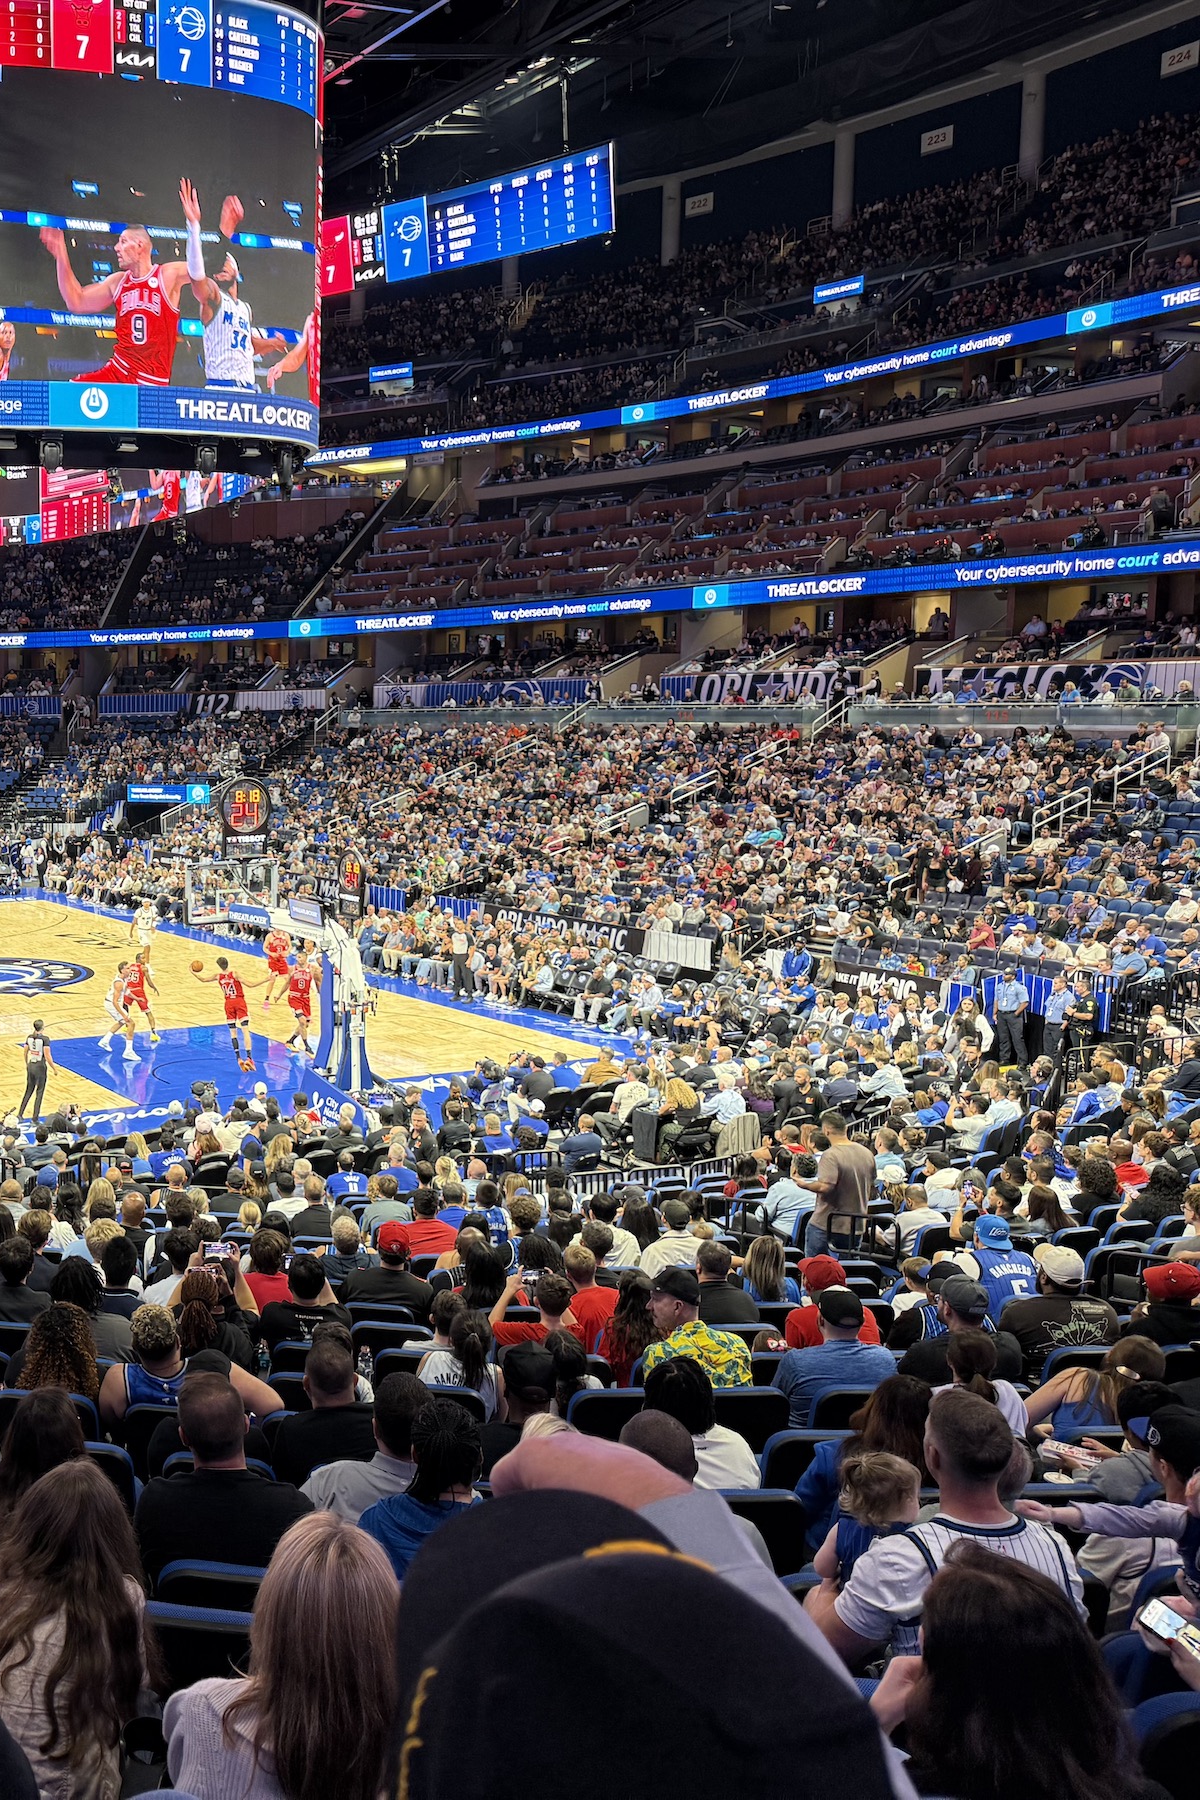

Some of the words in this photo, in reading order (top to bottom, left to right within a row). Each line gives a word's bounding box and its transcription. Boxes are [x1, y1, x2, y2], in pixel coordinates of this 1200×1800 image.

[130, 14, 141, 23] FLS
[228, 16, 248, 30] BLACK
[129, 23, 141, 33] TOL
[130, 33, 142, 42] CHL
[76, 35, 89, 59] 7
[179, 48, 191, 72] 7
[1168, 50, 1192, 67] 224
[927, 132, 947, 146] 223
[690, 198, 708, 210] 222
[353, 211, 378, 229] 8:18
[403, 248, 412, 266] 7
[326, 266, 336, 282] 7
[816, 282, 860, 298] THREATLOCKER
[131, 314, 147, 344] 9
[231, 330, 247, 351] 34
[824, 372, 843, 382] Your
[844, 359, 901, 380] cybersecurity
[903, 352, 929, 365] home
[931, 344, 957, 358] court
[960, 334, 1011, 353] advantage
[372, 368, 412, 377] THREATLOCKER
[688, 388, 769, 410] THREATLOCKER
[176, 399, 312, 430] THREATLOCKER
[440, 432, 490, 448] cybersecurity
[492, 430, 515, 439] home
[517, 426, 539, 436] court
[540, 420, 580, 433] advantage
[304, 445, 372, 462] REATLOCKER
[955, 569, 983, 581] Your
[986, 560, 1072, 581] cybersecurity
[1075, 558, 1114, 571] home
[1118, 552, 1159, 568] court
[767, 577, 864, 598] THREATLOCKER
[492, 610, 510, 619] Your
[511, 605, 563, 620] cybersecurity
[564, 605, 586, 614] home
[587, 602, 608, 612] court
[610, 599, 651, 610] advantage
[356, 615, 434, 629] THREATLOCKER
[90, 634, 108, 642] Your
[110, 632, 163, 643] cybersecurity
[164, 631, 187, 639] home
[188, 630, 210, 638] court
[212, 628, 254, 638] advantage
[196, 694, 229, 714] 112
[985, 707, 1008, 718] 115
[236, 790, 260, 802] 8:18
[231, 803, 258, 826] 24
[346, 874, 358, 888] 24
[229, 911, 268, 925] THREATLOCKER
[222, 984, 236, 996] 14
[298, 980, 305, 988] 9
[835, 972, 849, 982] AKE
[849, 975, 859, 985] IT
[857, 972, 917, 1000] MAGIC
[326, 1096, 339, 1110] City
[324, 1106, 340, 1121] Natio
[989, 1264, 1032, 1278] BANCHERO
[434, 1372, 464, 1386] BANCH
